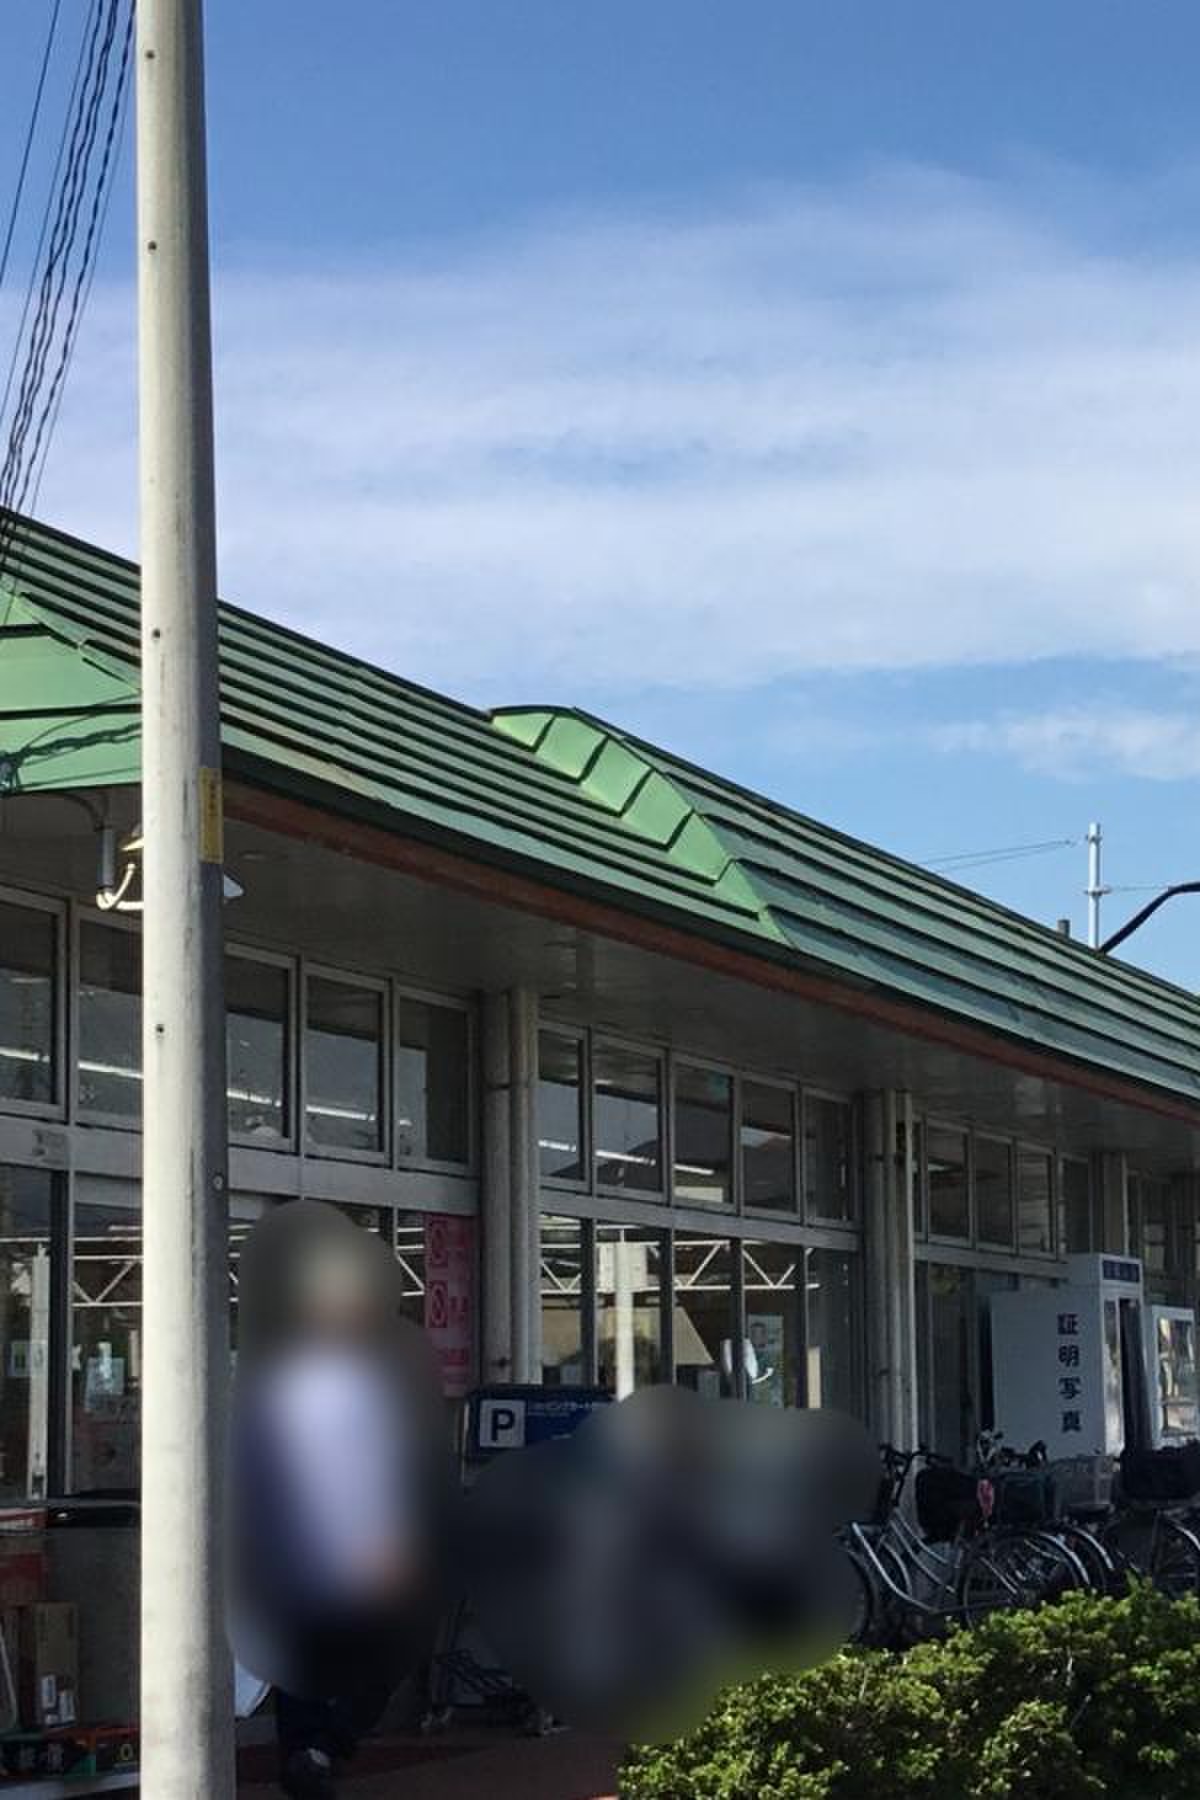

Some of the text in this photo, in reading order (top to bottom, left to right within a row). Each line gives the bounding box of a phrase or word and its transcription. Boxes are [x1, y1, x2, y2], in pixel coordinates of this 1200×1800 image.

[1056, 1312, 1082, 1434] 証明写真
[490, 1408, 516, 1443] P
